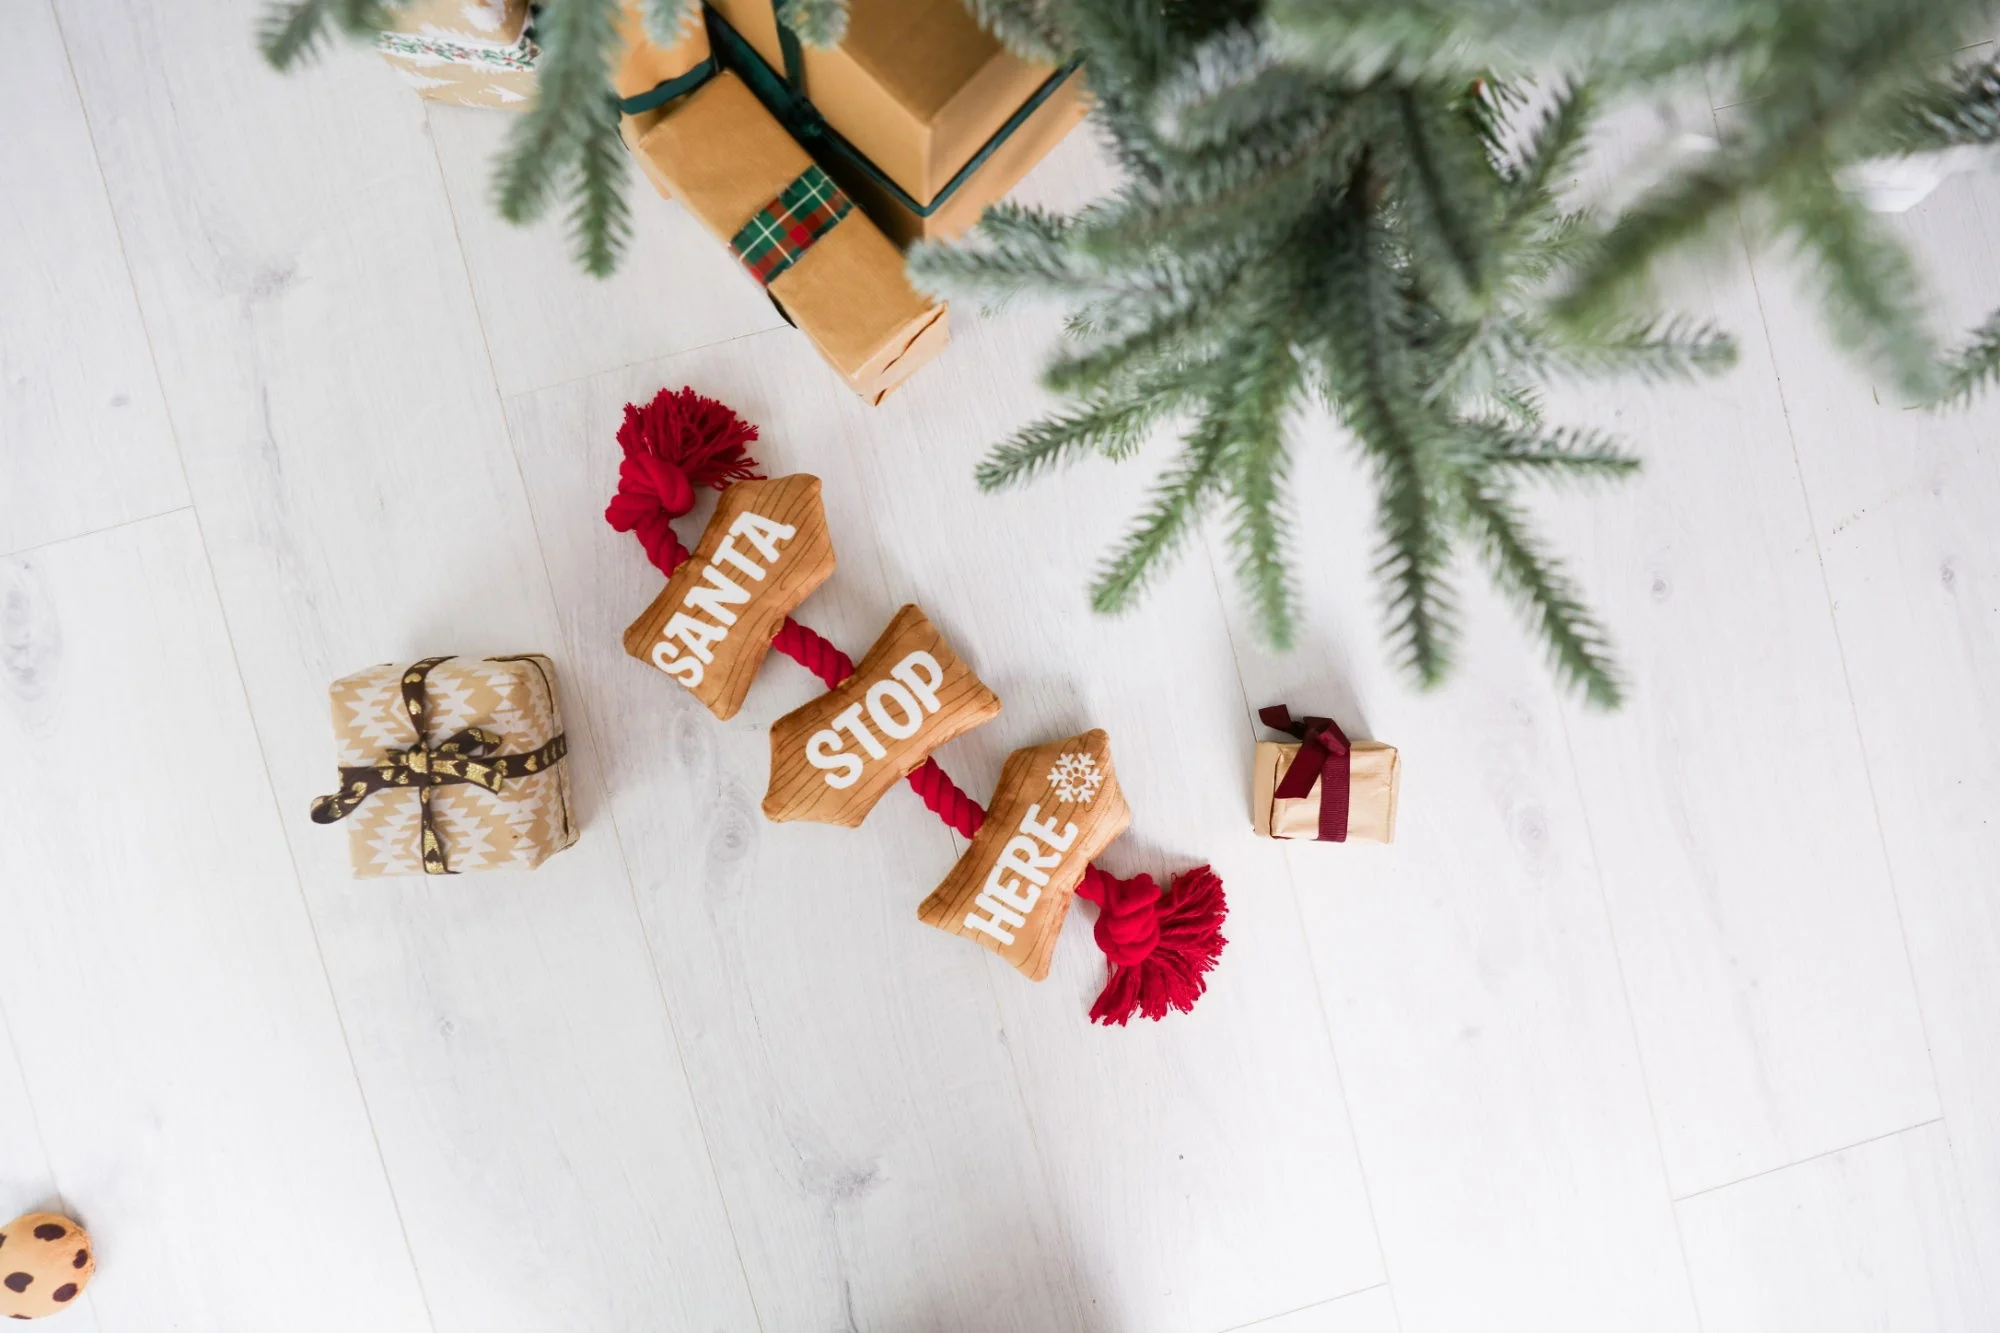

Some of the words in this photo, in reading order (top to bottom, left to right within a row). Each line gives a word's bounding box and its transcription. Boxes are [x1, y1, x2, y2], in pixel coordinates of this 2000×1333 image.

[651, 511, 796, 688] SANTA
[806, 651, 943, 789] STOP
[963, 804, 1078, 945] HERE
